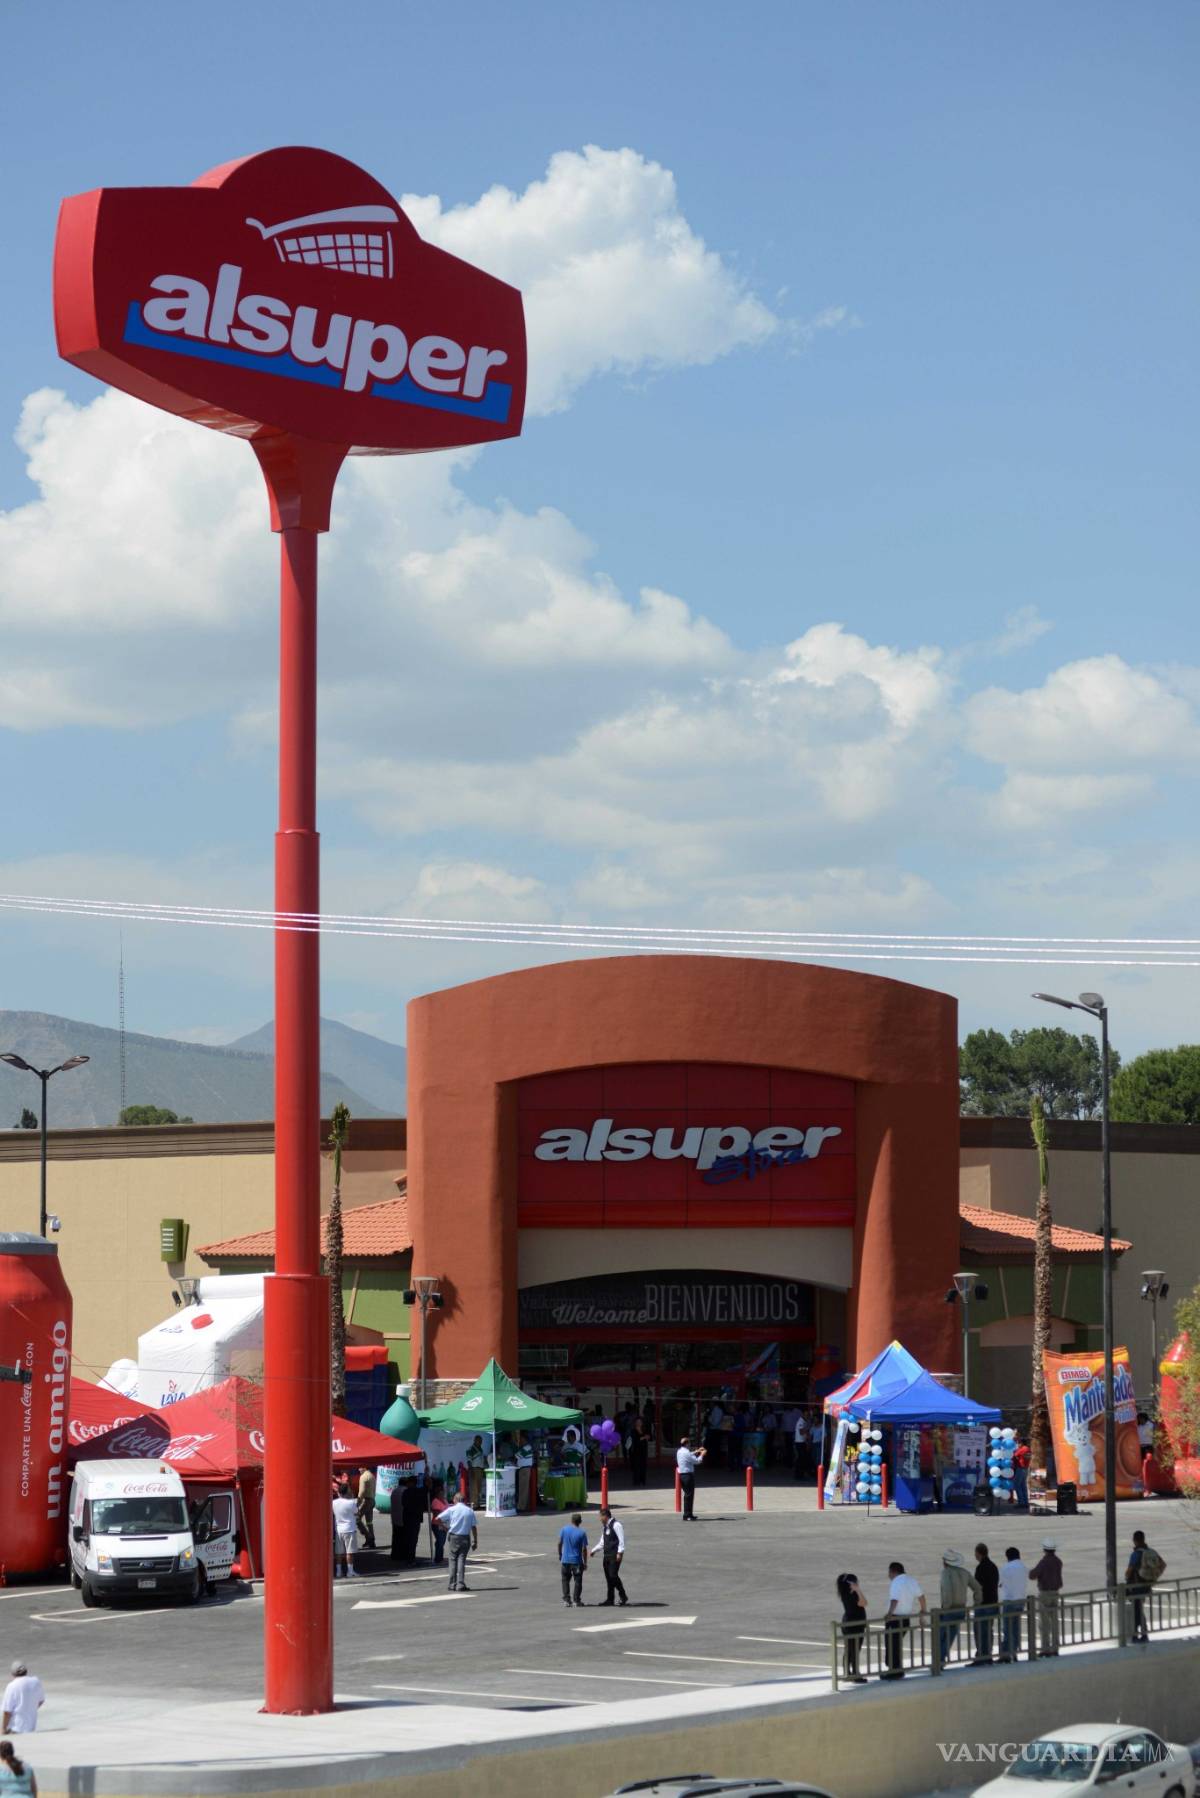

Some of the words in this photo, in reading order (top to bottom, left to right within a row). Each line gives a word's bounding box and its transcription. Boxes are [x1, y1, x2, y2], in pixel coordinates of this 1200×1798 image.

[143, 263, 508, 398] alsuper
[534, 1118, 842, 1170] alsuper
[552, 1303, 648, 1325] Welcome
[644, 1283, 799, 1323] BIENVENIDOS
[26, 1342, 34, 1367] CON
[1061, 1370, 1090, 1380] BIMBO
[44, 1320, 68, 1454] amigo
[23, 1409, 32, 1433] UNA
[21, 1435, 31, 1497] COMPARTE
[47, 1462, 62, 1520] un
